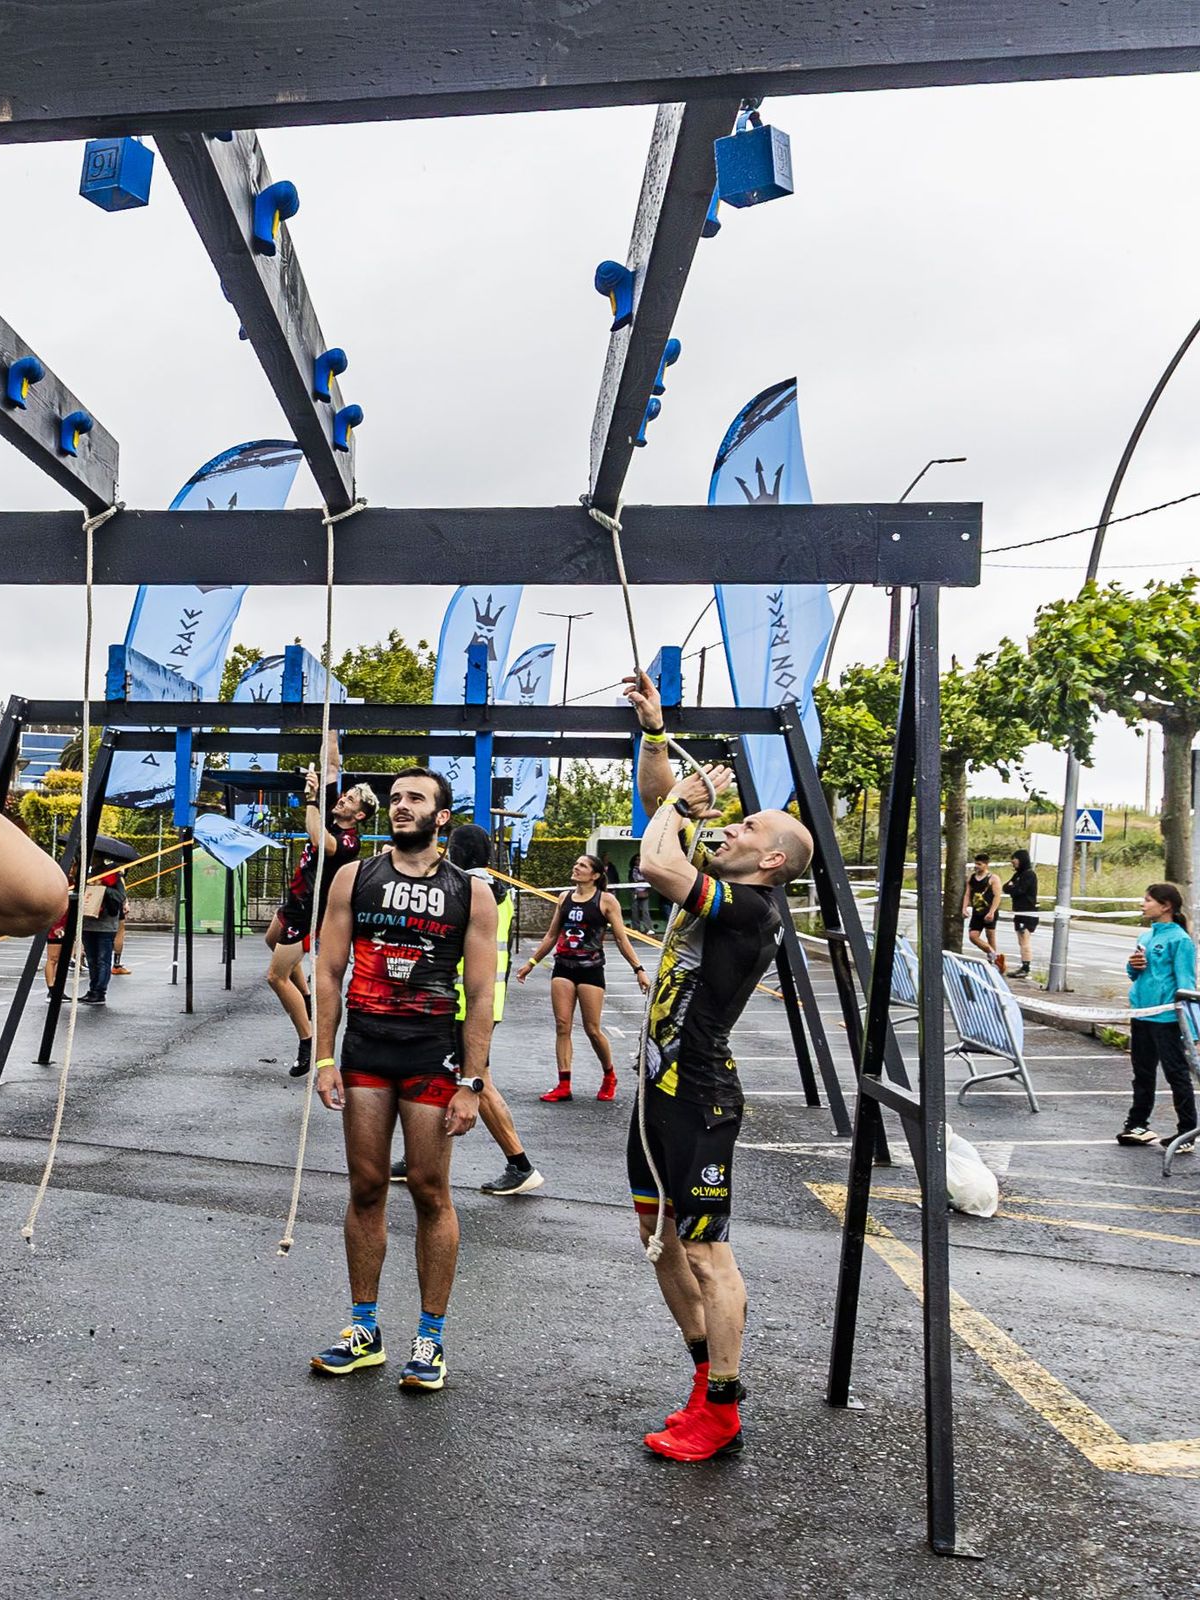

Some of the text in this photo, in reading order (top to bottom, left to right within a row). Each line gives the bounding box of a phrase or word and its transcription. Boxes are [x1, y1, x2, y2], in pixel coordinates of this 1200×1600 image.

[169, 608, 203, 657] RACE
[765, 589, 790, 649] RACE
[381, 880, 445, 917] 1659
[568, 910, 584, 922] 48
[691, 1186, 728, 1197] OLYMPUS
